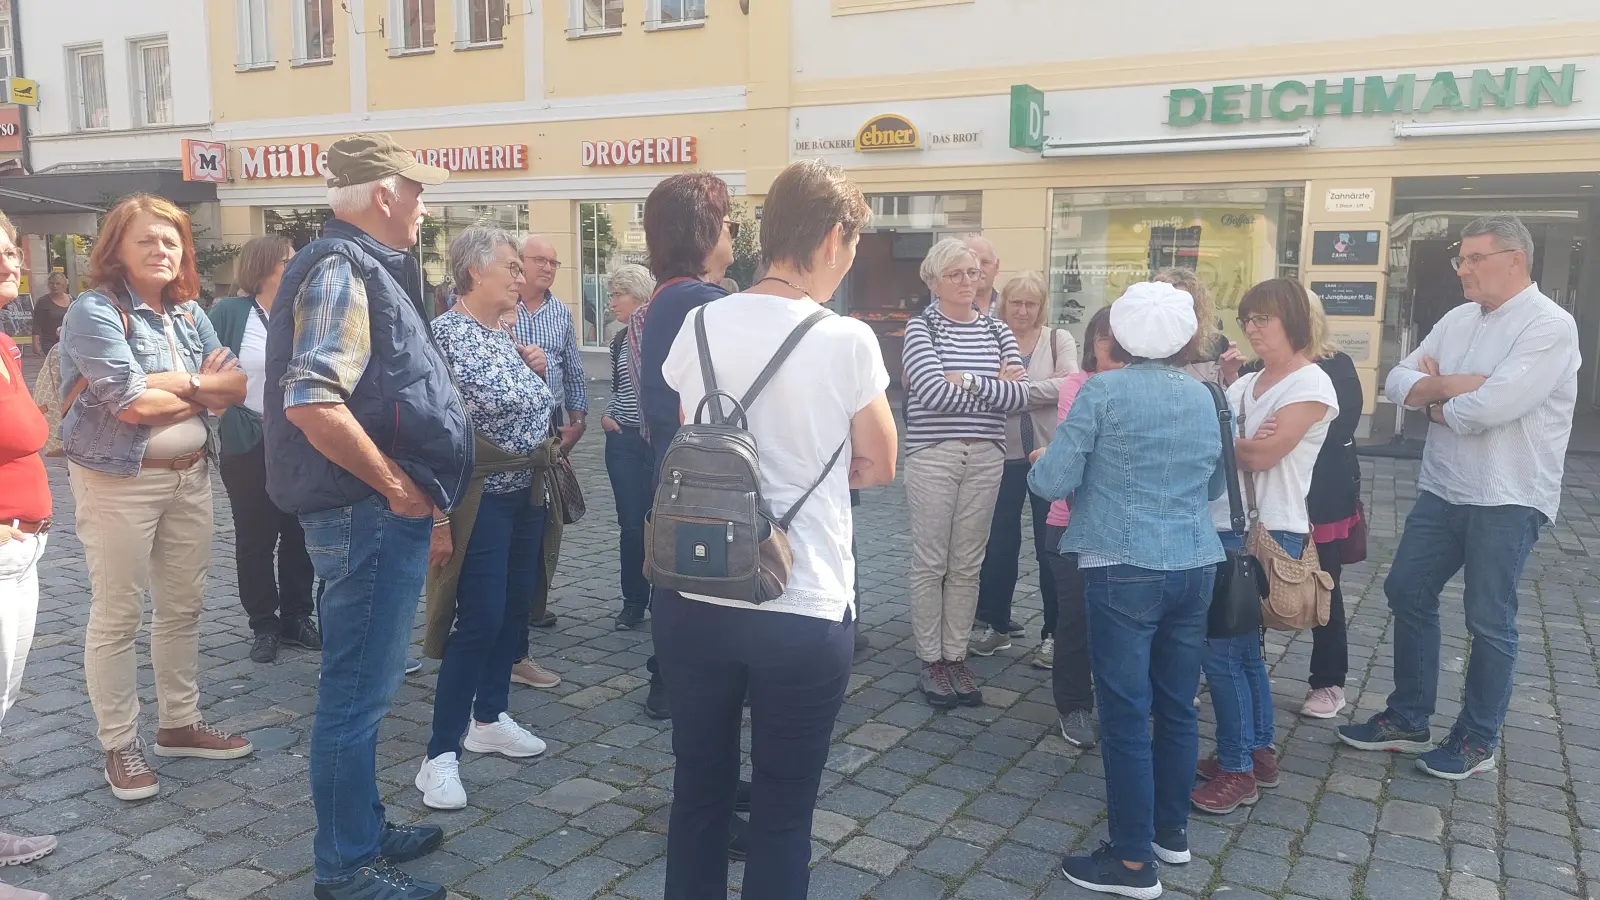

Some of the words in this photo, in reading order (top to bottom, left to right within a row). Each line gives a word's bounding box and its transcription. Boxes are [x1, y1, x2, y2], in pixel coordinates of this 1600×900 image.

[1168, 64, 1575, 127] DEICHMANN
[1029, 101, 1041, 140] D
[795, 141, 810, 151] DIE
[862, 125, 913, 146] ebner
[932, 134, 950, 144] DAS
[952, 132, 979, 143] BROT
[199, 153, 218, 171] M
[239, 143, 329, 179] Mülle
[414, 144, 528, 172] ARFUMERIE
[582, 137, 696, 167] DROGERIE
[1330, 192, 1370, 200] Zahnärzte
